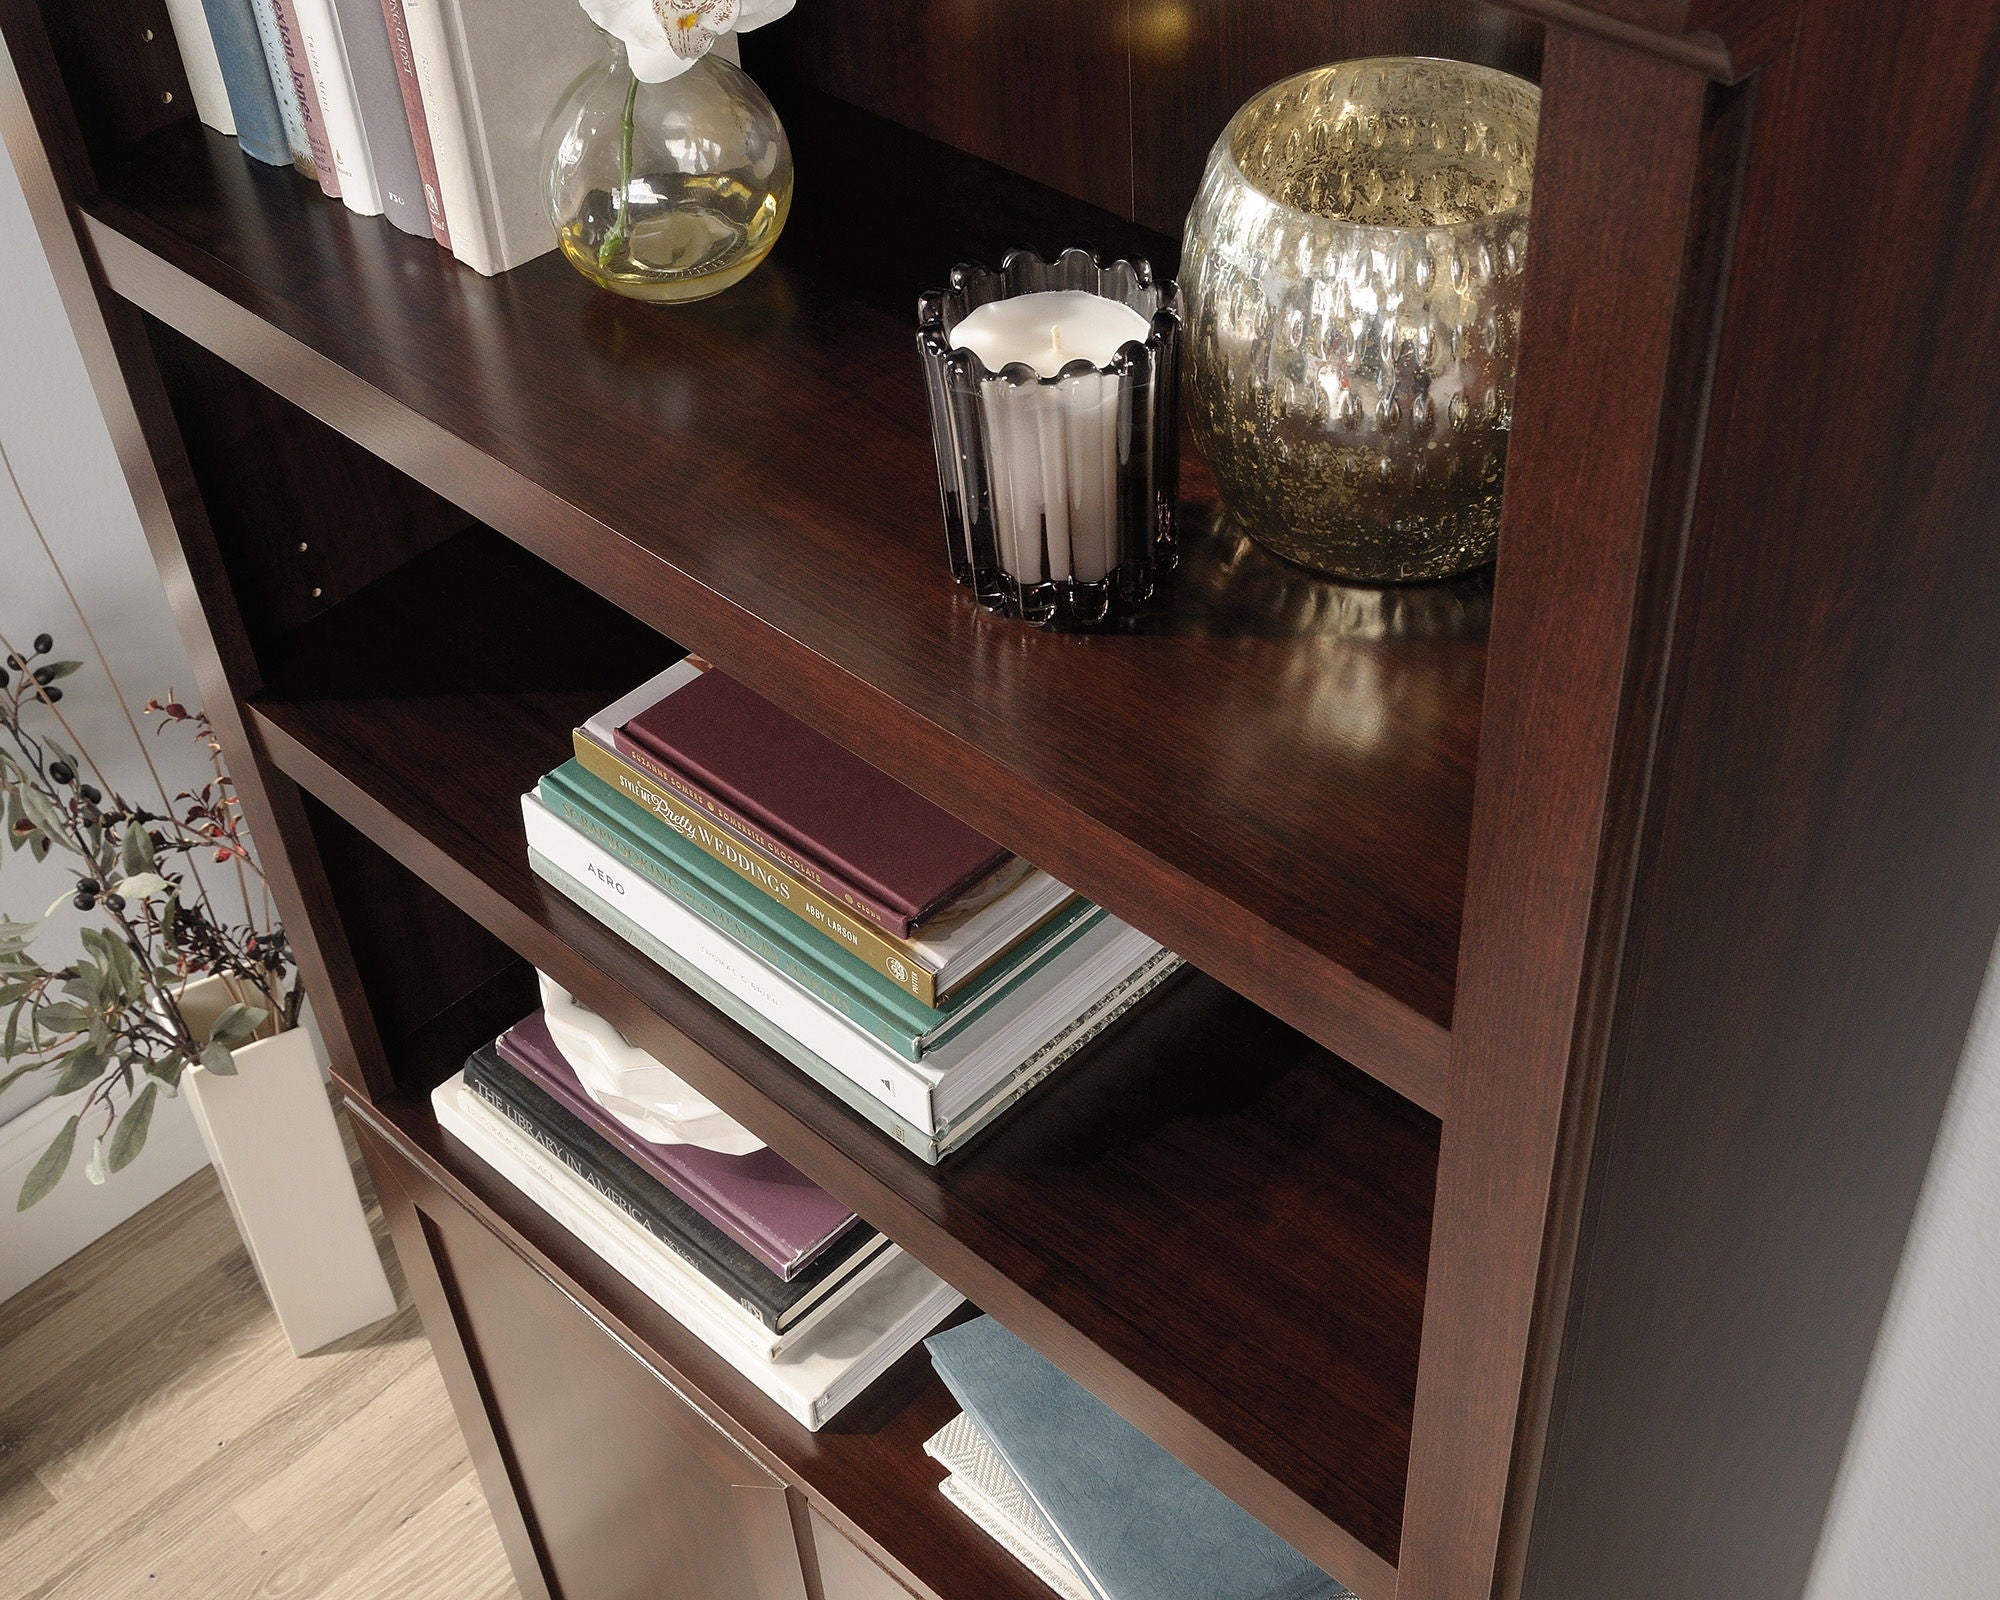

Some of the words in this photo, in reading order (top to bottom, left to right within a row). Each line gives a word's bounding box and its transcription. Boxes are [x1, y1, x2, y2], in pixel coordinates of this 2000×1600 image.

[395, 27, 413, 77] GHOST
[290, 64, 313, 122] Jones
[619, 775, 640, 797] STYLE
[637, 780, 697, 841] Pretty
[639, 790, 652, 805] ME
[631, 751, 668, 780] SUZANNE
[670, 777, 703, 804] SOMERS
[767, 842, 822, 883] CHOCOLATE
[587, 862, 625, 895] AERO
[698, 826, 791, 899] WEDDINGS
[805, 902, 825, 922] ABBY
[827, 916, 859, 945] LARSON
[474, 1079, 503, 1111] THE
[506, 1103, 563, 1159] LIBRARY
[566, 1150, 583, 1175] IN
[586, 1172, 653, 1233] AMERICA
